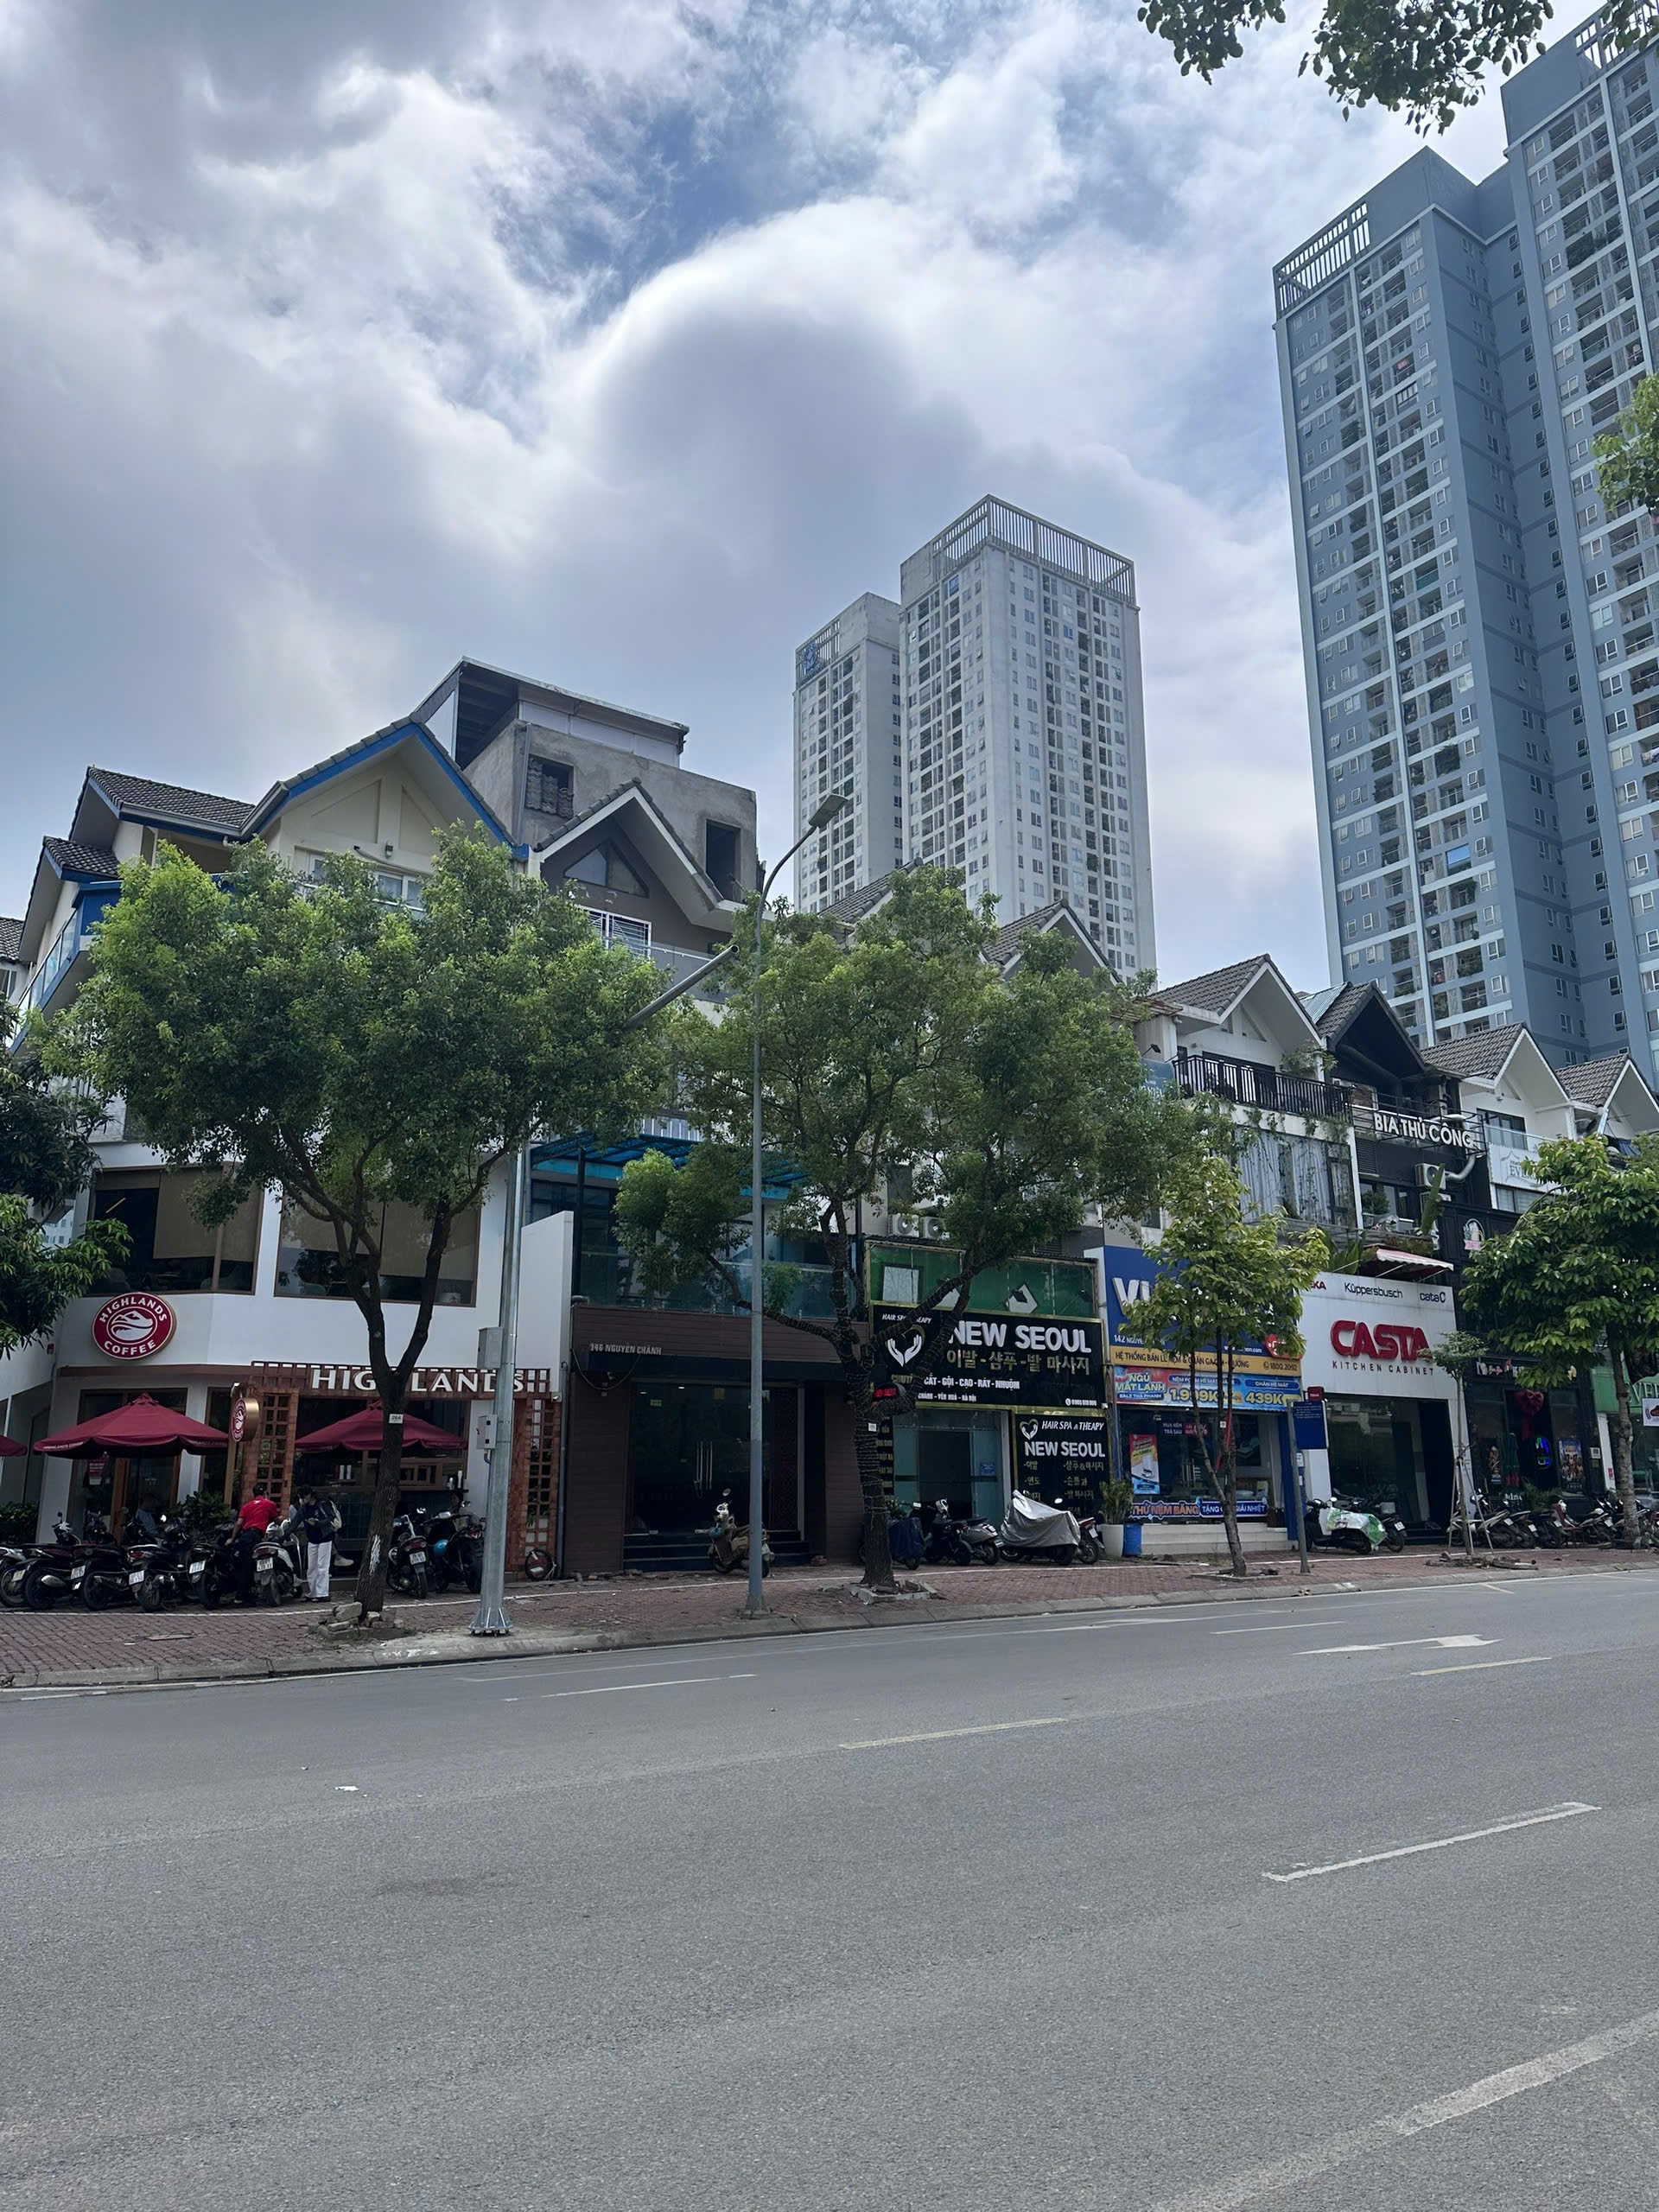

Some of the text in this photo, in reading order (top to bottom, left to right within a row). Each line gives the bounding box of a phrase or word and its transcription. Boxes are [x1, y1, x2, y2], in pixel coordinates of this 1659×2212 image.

[1374, 1112, 1474, 1148] BIA THỦ CÔNG
[99, 1296, 168, 1323] HIGHLANDS
[948, 1320, 1092, 1353] NEW SEOUL
[1114, 1334, 1125, 1343] 142
[1330, 1319, 1433, 1363] CASTA
[105, 1339, 156, 1356] COFFEE
[946, 1350, 977, 1369] 이발
[988, 1351, 1018, 1371] 샴푸
[1047, 1356, 1090, 1376] 마사지
[1269, 1362, 1298, 1371] 1800.2092
[1332, 1360, 1434, 1376] KITCHEN CABINET
[312, 1369, 524, 1393] HIGLANS
[1128, 1371, 1151, 1382] NGỦ
[1245, 1391, 1282, 1405] 439K
[1041, 1420, 1058, 1430] HAIR
[1058, 1421, 1072, 1430] SPA
[1079, 1422, 1105, 1431] THEAPY
[1024, 1441, 1106, 1458] NEW SEOUL
